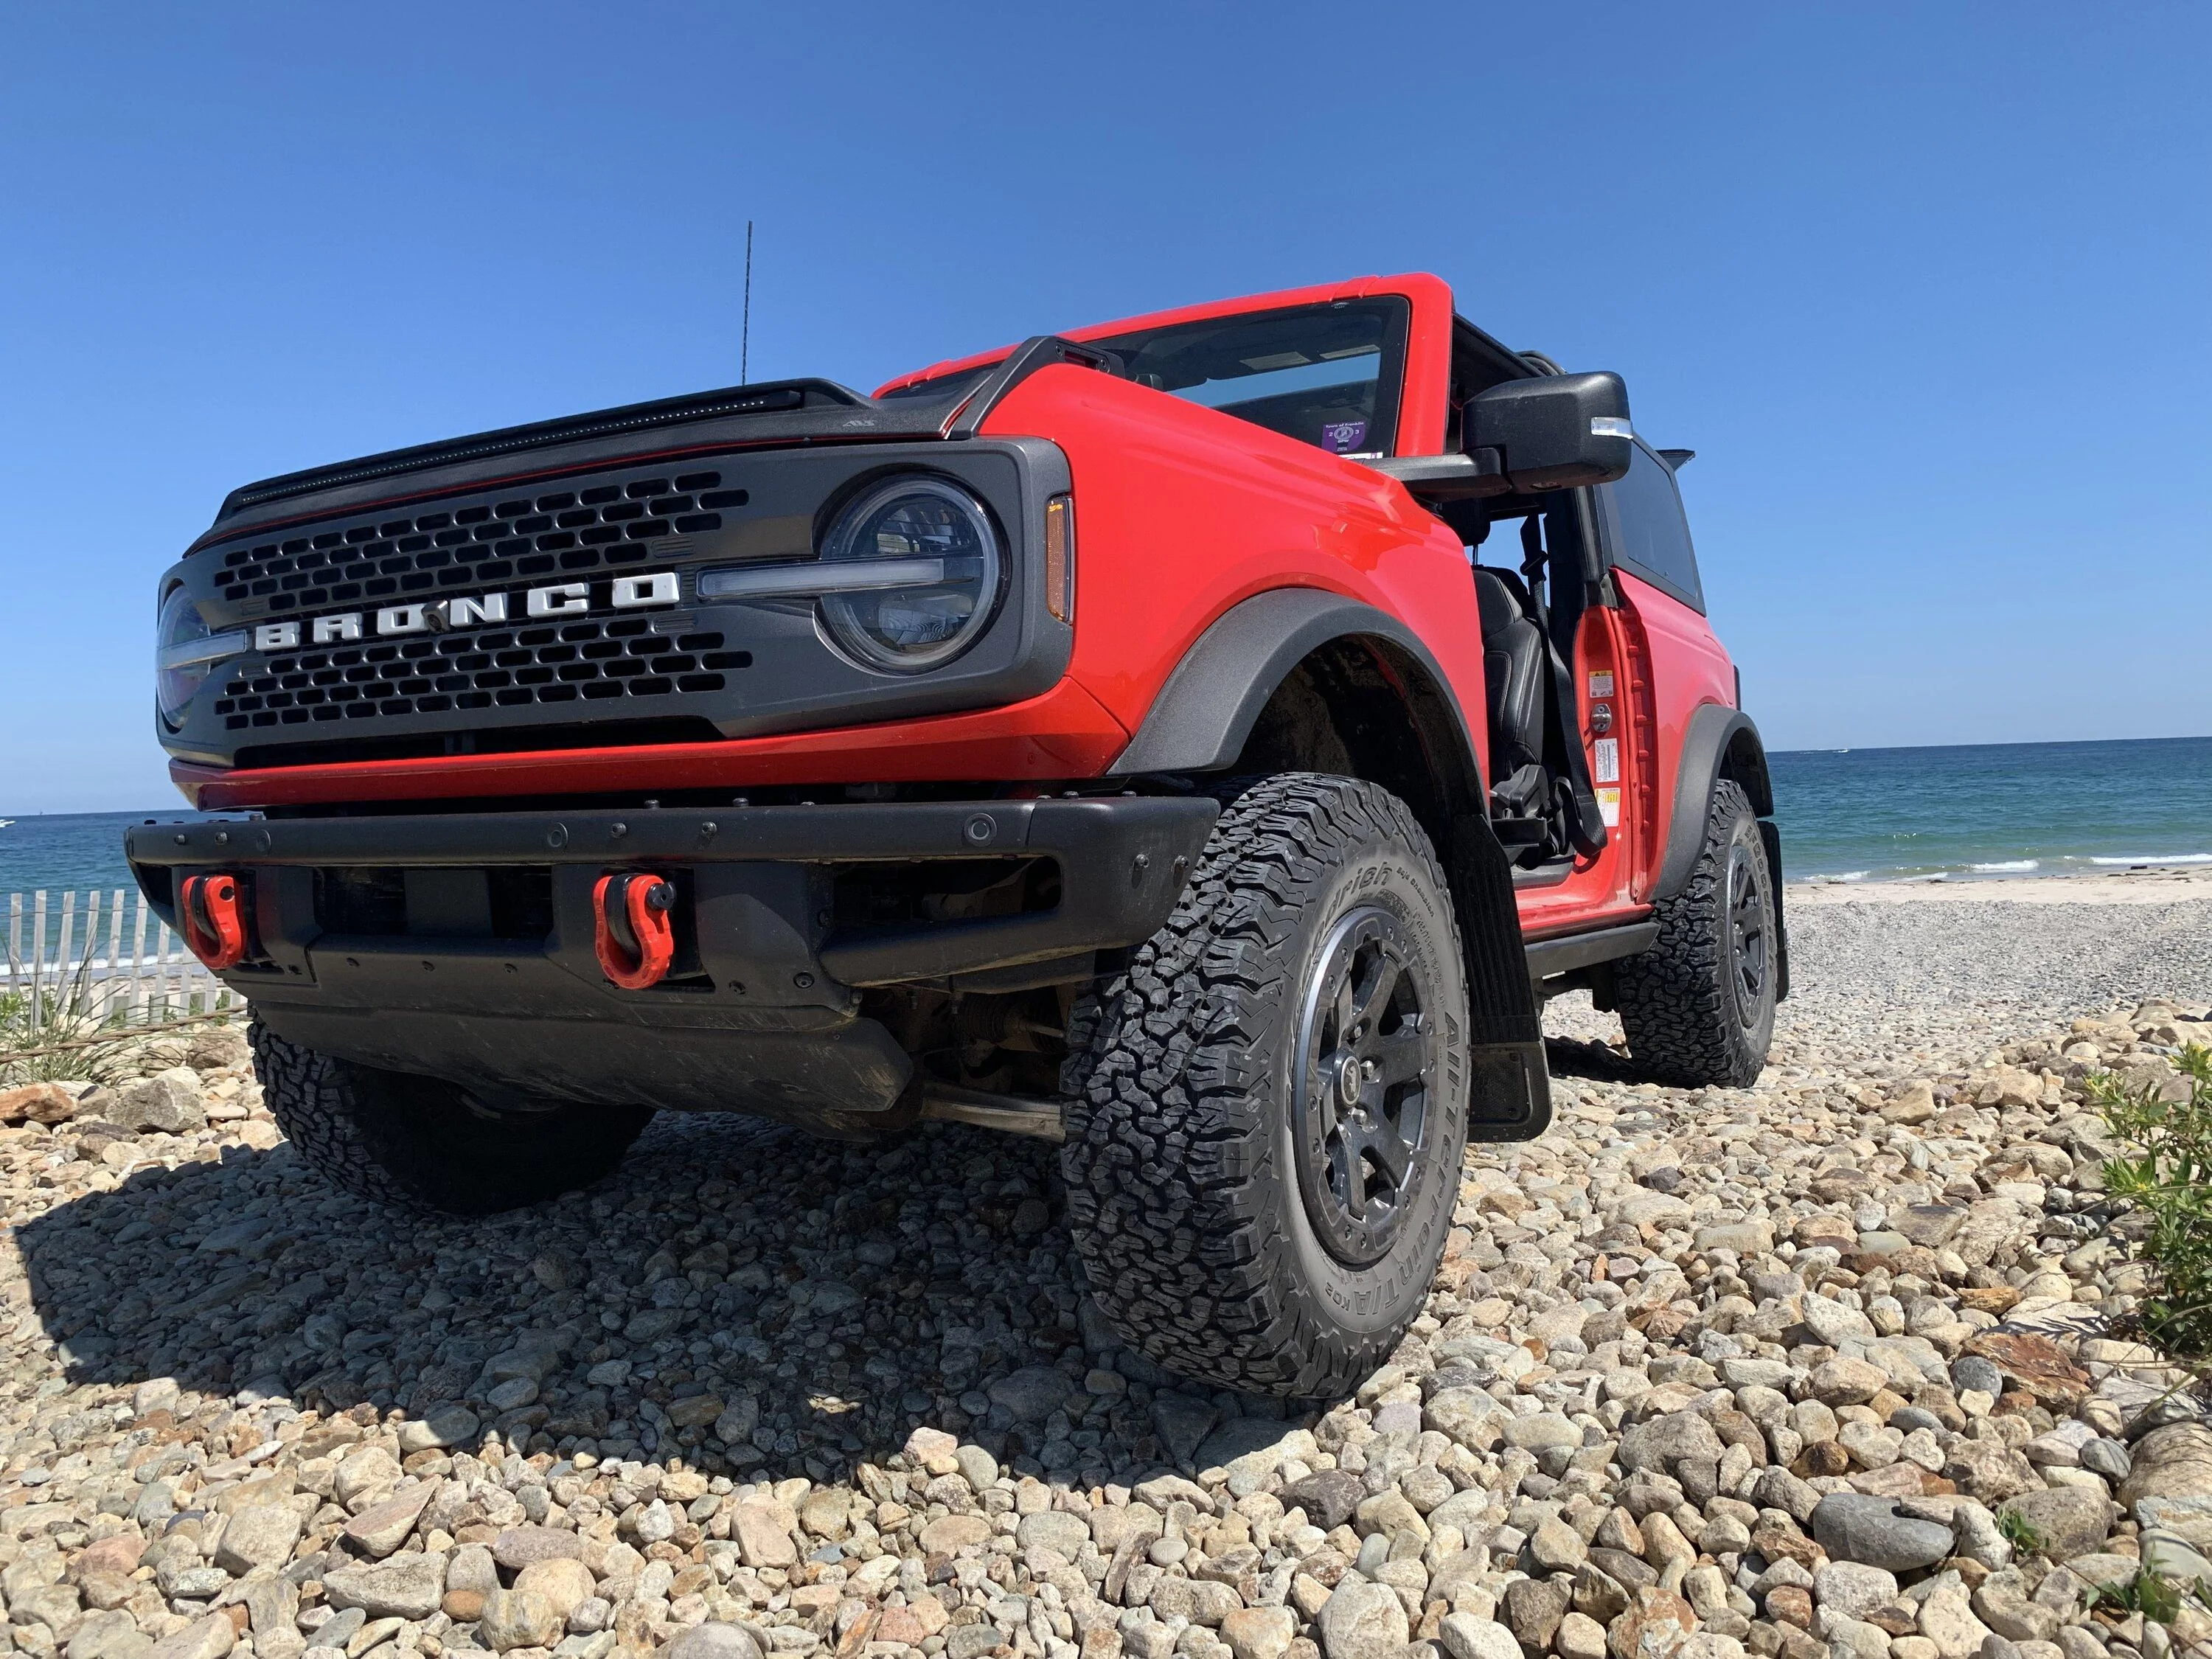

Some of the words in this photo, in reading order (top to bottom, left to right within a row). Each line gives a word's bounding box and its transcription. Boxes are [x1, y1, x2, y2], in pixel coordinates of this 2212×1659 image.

[255, 572, 681, 652] BRONCO
[1399, 1012, 1460, 1285] All-Terrain
[1325, 1281, 1350, 1311] KO2
[1354, 1278, 1399, 1315] T/A
